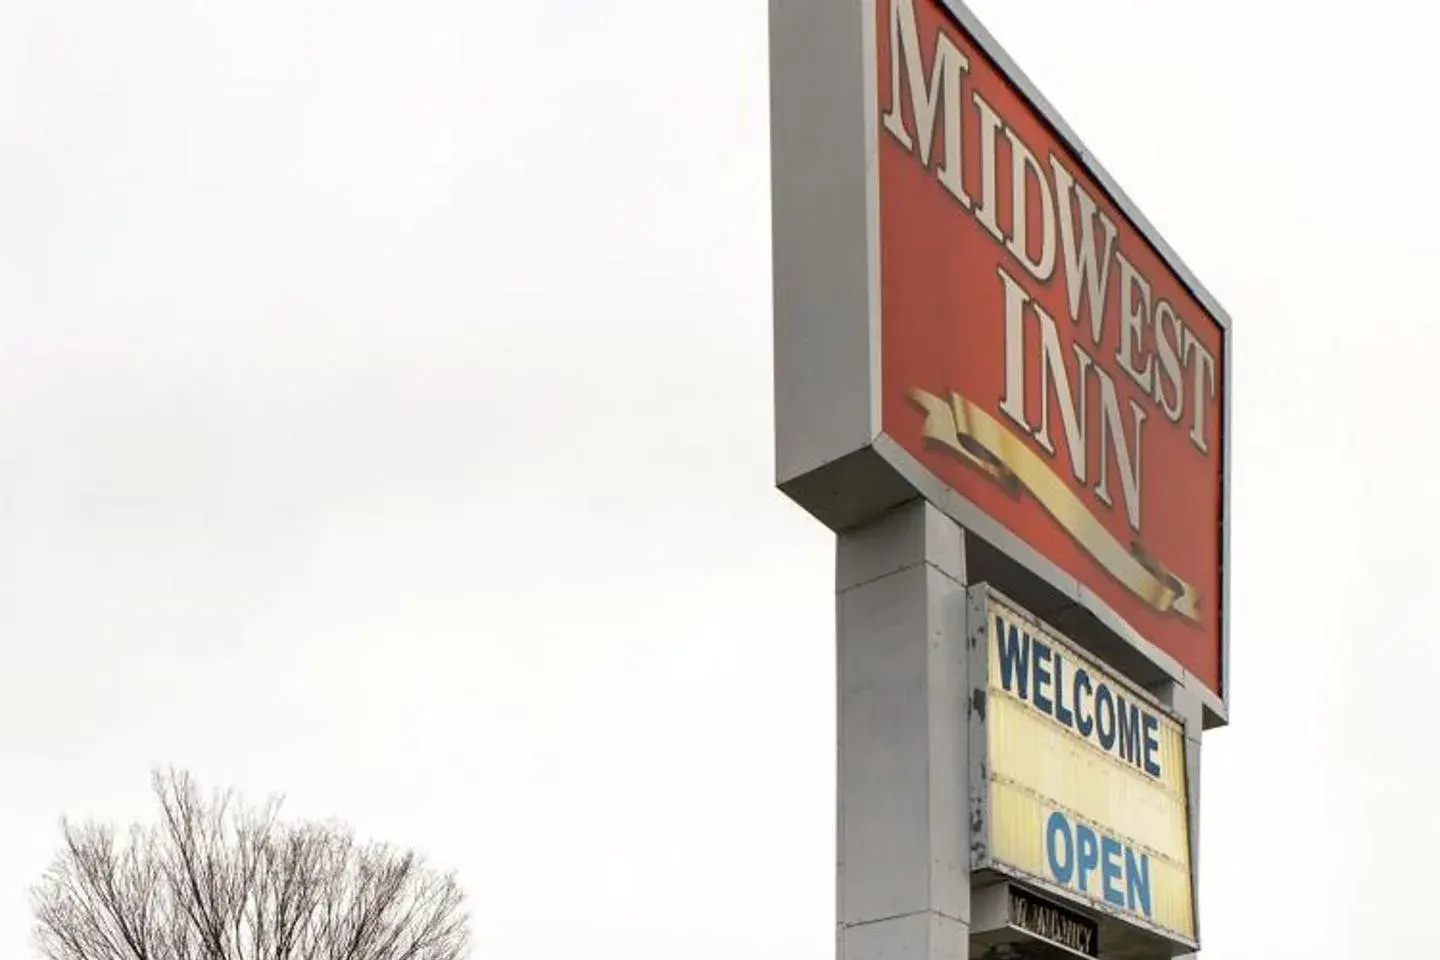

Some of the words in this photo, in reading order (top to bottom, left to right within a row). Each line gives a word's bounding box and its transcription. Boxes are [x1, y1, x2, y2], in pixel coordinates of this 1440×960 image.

[881, 0, 1215, 455] MIDWEST
[997, 265, 1148, 533] INN
[996, 615, 1161, 779] WELCOME
[1045, 810, 1152, 918] OPEN
